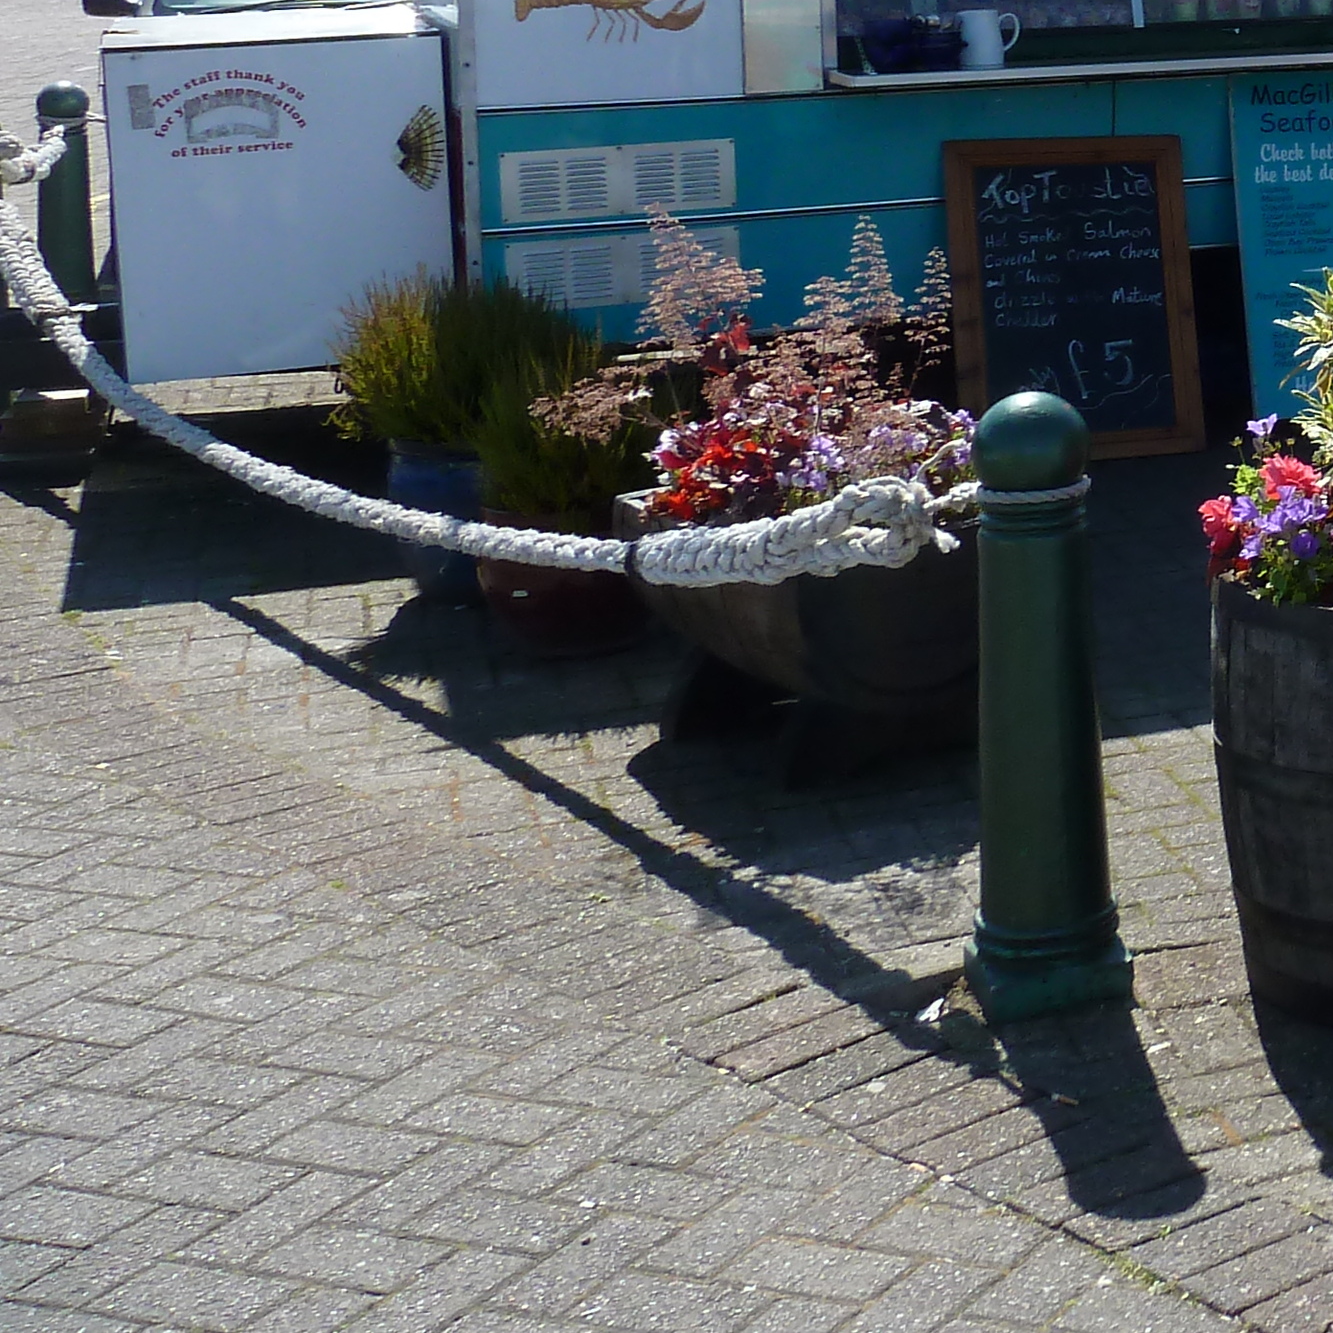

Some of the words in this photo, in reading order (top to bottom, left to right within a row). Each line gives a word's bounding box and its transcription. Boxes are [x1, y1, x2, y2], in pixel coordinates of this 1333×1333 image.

[152, 88, 181, 110] The
[183, 70, 220, 90] staff
[226, 69, 276, 84] thank
[277, 80, 306, 102] you
[155, 115, 174, 137] for
[171, 147, 187, 157] of
[192, 144, 233, 156] their
[237, 141, 294, 153] service
[1260, 143, 1305, 163] Check
[1254, 166, 1277, 183] the
[1283, 164, 1313, 182] best
[1084, 221, 1151, 239] Salmon
